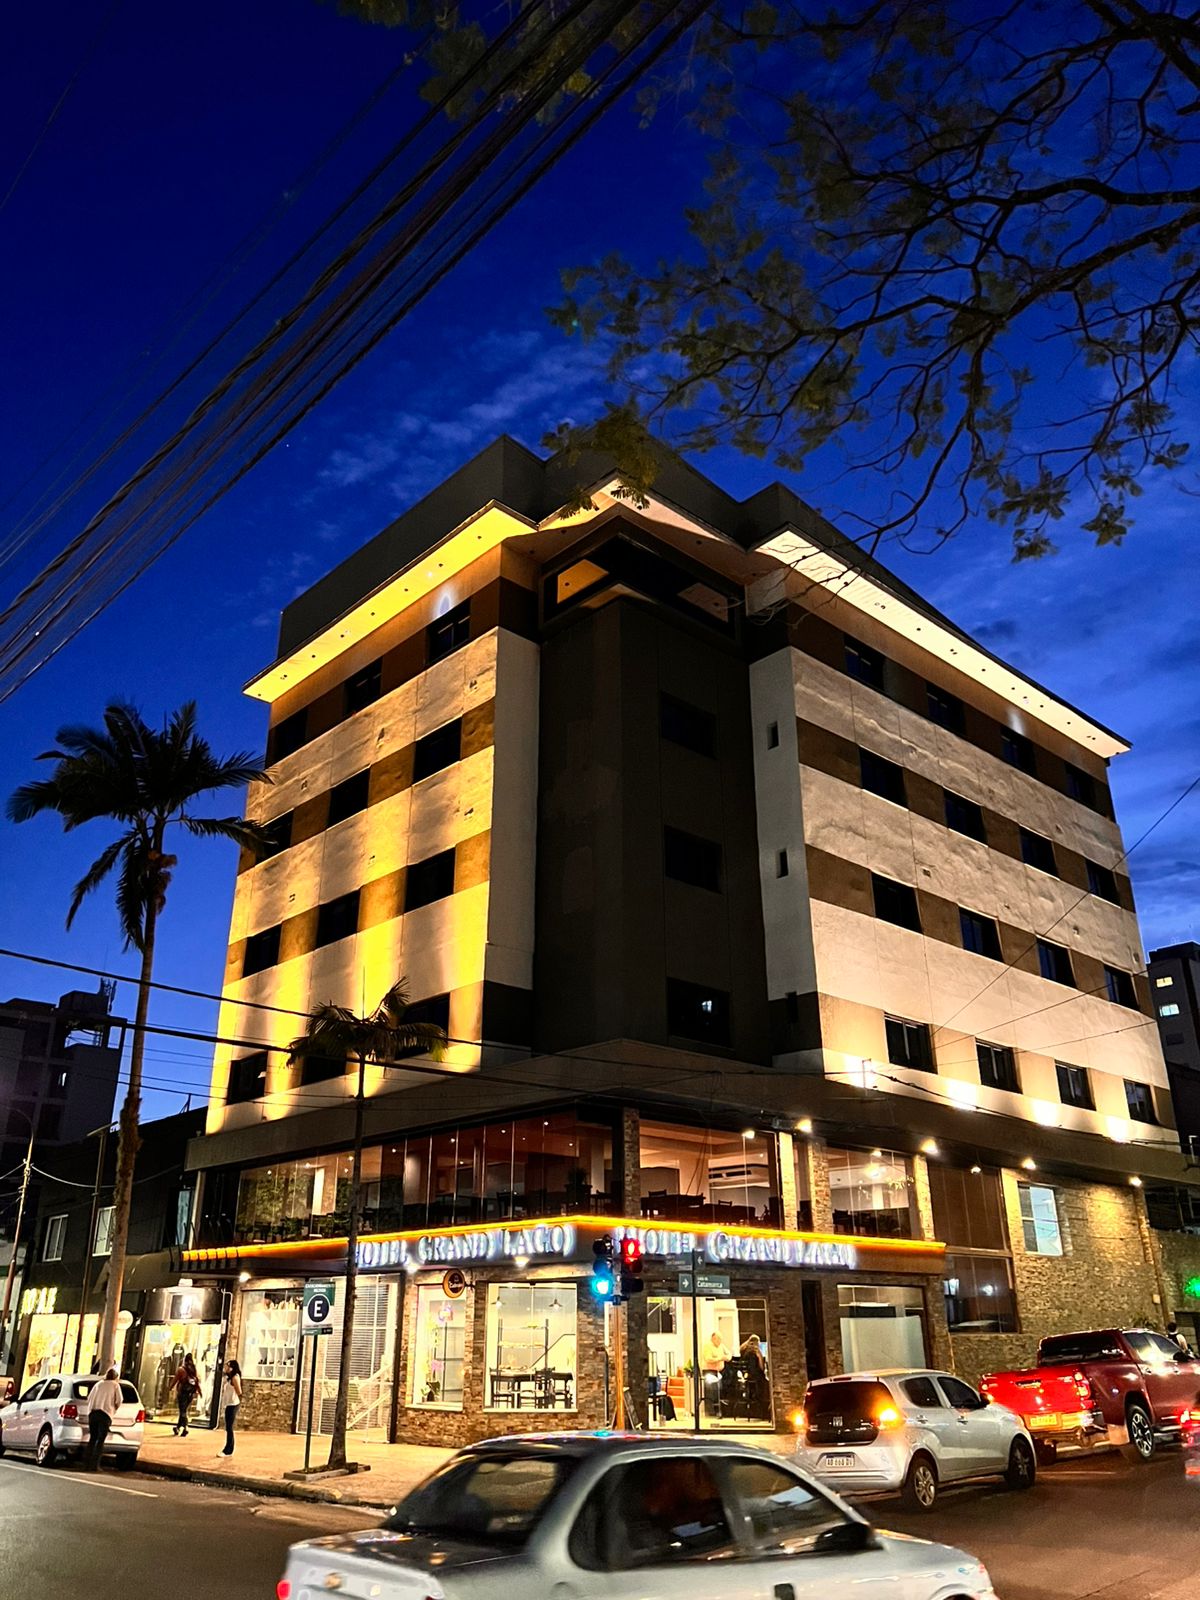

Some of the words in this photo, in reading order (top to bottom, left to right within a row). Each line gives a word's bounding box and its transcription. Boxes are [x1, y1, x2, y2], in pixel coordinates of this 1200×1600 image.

[418, 1233, 492, 1263] GRAND
[500, 1225, 573, 1257] LAGO
[705, 1231, 792, 1264] GRAND
[793, 1241, 858, 1270] LAGO
[313, 1300, 324, 1318] E
